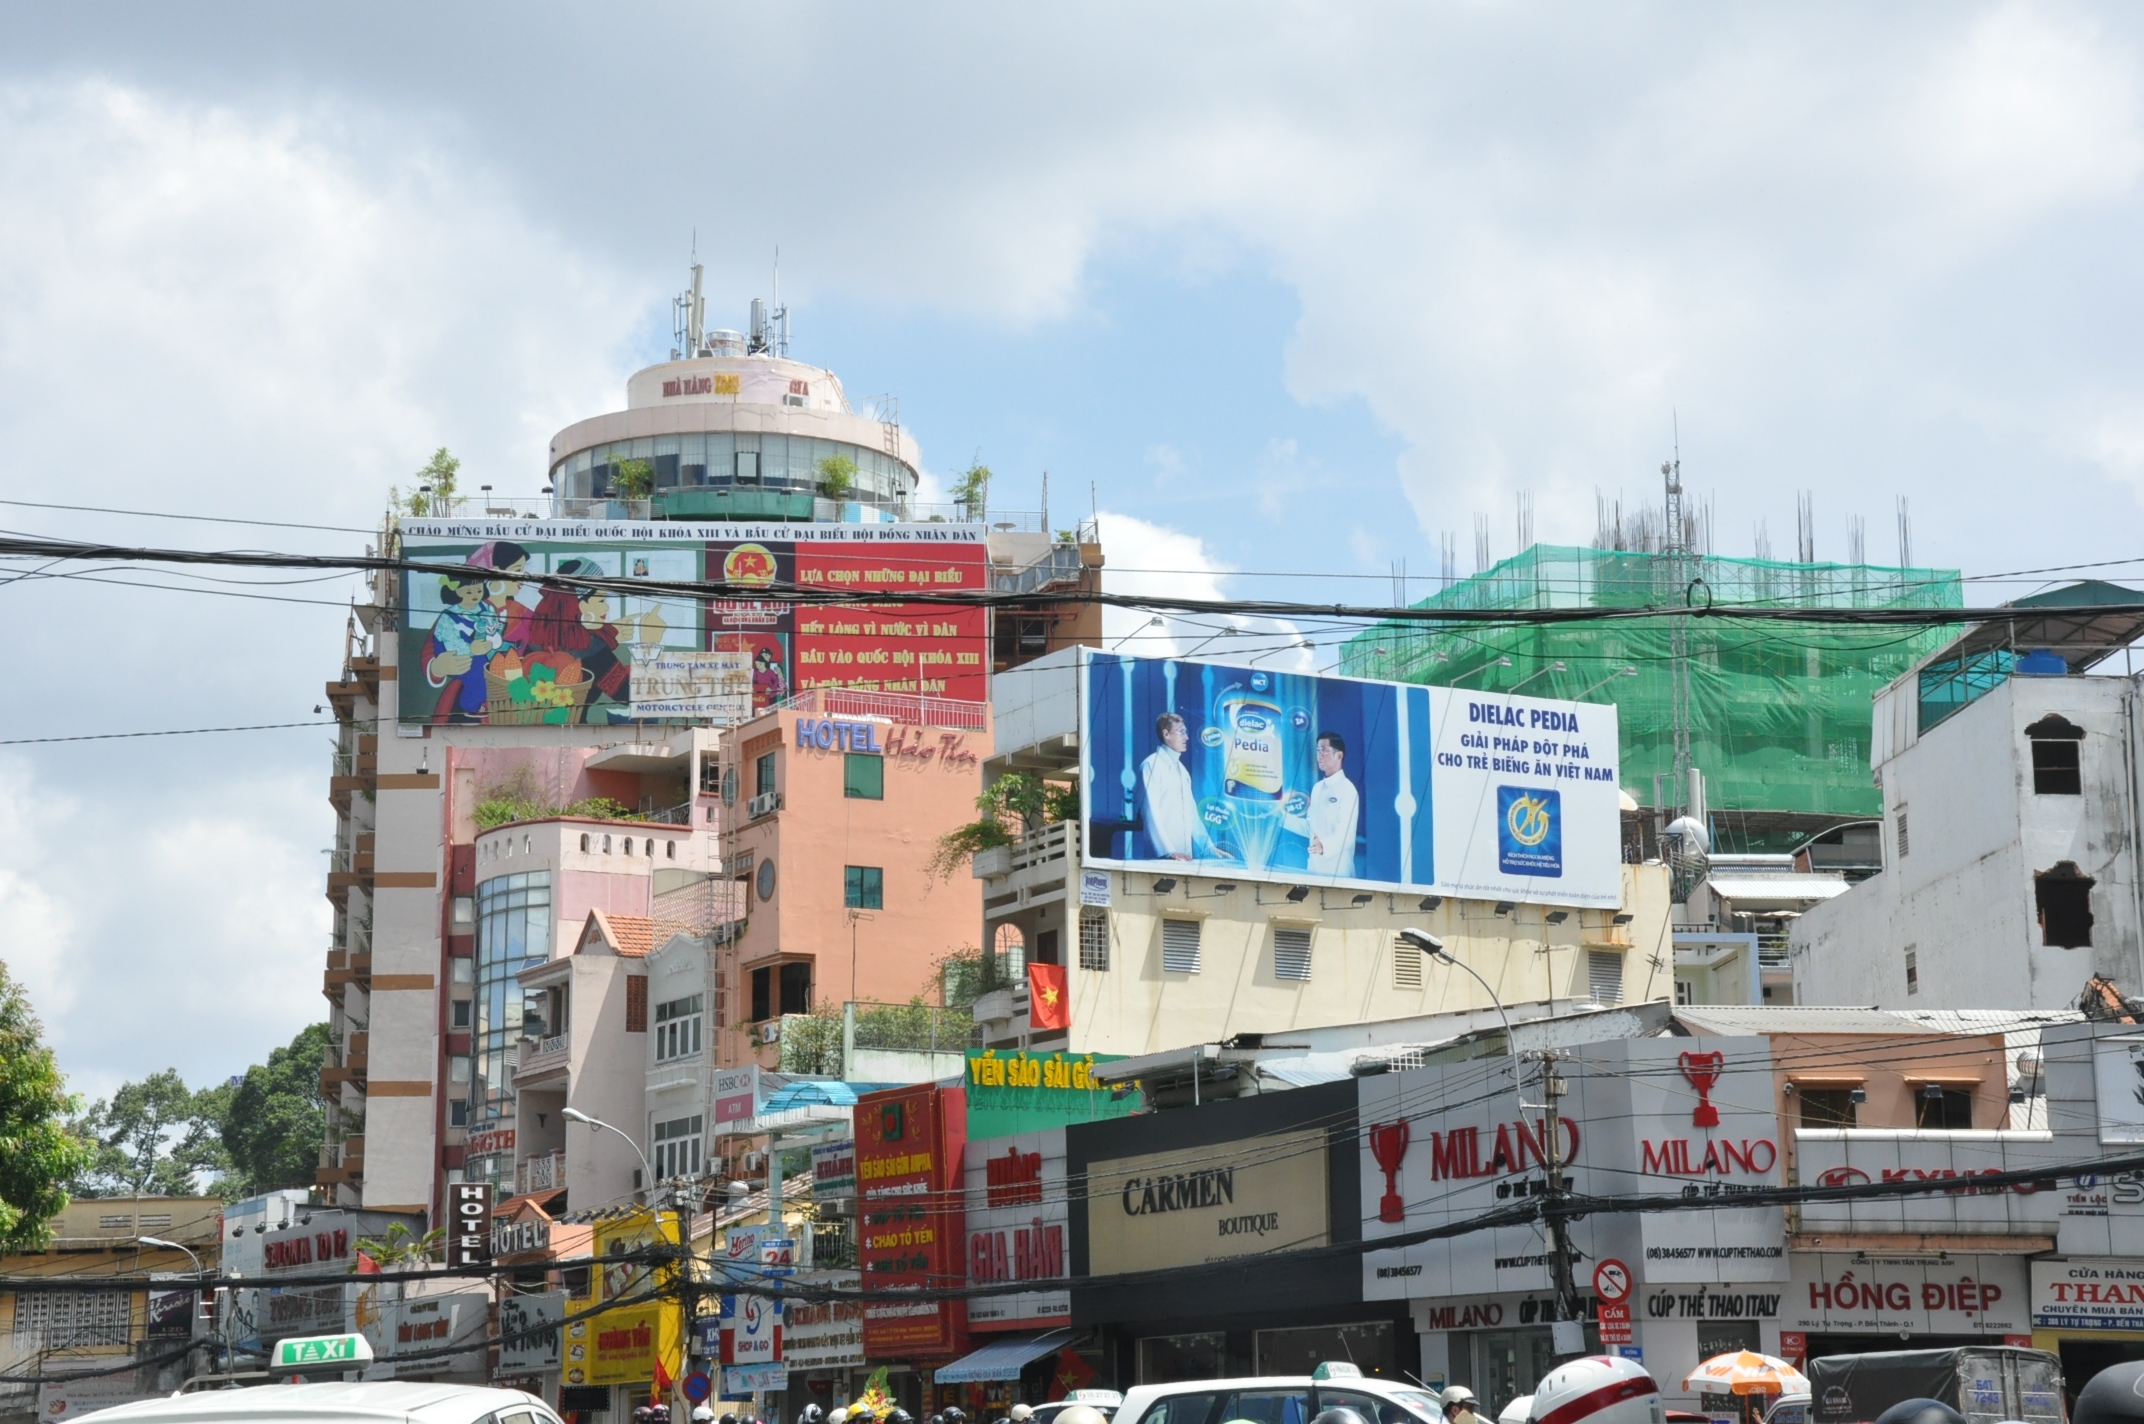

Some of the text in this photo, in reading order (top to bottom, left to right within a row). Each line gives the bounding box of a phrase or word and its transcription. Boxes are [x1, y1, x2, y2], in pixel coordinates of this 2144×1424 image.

[662, 376, 682, 398] NHÀ
[683, 374, 712, 396] HÀNG
[408, 523, 442, 536] CHÀO
[447, 522, 480, 536] MỪNG
[515, 522, 532, 536] CỬ
[535, 526, 557, 541] ĐẠI
[562, 523, 591, 537] BIỂU
[595, 524, 627, 538] QUỐC
[631, 526, 654, 541] HỘI
[659, 525, 692, 538] KHÓA
[697, 527, 720, 538] XIII
[724, 526, 740, 538] VÀ
[773, 526, 791, 539] CỬ
[794, 529, 815, 542] ĐẠI
[820, 526, 848, 540] BIỂU
[852, 528, 874, 542] HỘI
[879, 527, 910, 541] ĐỒNG
[915, 527, 948, 541] NHÂN
[952, 528, 977, 541] DÂN
[800, 566, 963, 586] LỰA CHỌN NHỮNG ĐẠI BIỂU
[800, 620, 958, 637] HẾT LÒNG VÌ NƯỚC VÌ DÂN
[655, 662, 686, 670] TRUNG
[800, 648, 980, 667] BẦU VÀO QUỐC HỘI KHÓA XIII
[884, 677, 917, 692] NHÂN
[636, 702, 706, 712] MOTORCYCLE
[1239, 717, 1265, 729] dielac
[1469, 702, 1579, 733] DIELAC PEDIA
[796, 718, 882, 753] HOTEL
[1234, 738, 1269, 753] Pedia
[1460, 731, 1590, 760] GIẢI PHÁP ĐỘT PHÁ
[1437, 752, 1613, 782] CHO TRẺ BIẾNG ĂN VIỆT NAM
[969, 1048, 1071, 1089] YẾN SÀO SÀI
[718, 1075, 739, 1092] HSBC
[727, 1102, 741, 1114] ATM
[1430, 1116, 1580, 1182] MILANO
[1641, 1139, 1777, 1175] MILANO
[1122, 1166, 1234, 1217] CARMEN
[2066, 1193, 2107, 1205] TIẾN LỘC
[460, 1186, 484, 1264] HOTEL
[1218, 1212, 1279, 1237] BOUTIQUE
[489, 1219, 545, 1255] HOTEL
[731, 1232, 755, 1253] Merino
[873, 1224, 934, 1250] CHÁO TỔ YẾN
[765, 1249, 792, 1266] 24
[970, 1217, 1063, 1285] GIA HÂN
[1697, 1246, 1783, 1259] WWW.CUPTHETHAO.COM
[1851, 1257, 1871, 1266] CÔNG
[2068, 1266, 2144, 1280] CỬA HÀNG
[1648, 1286, 1781, 1318] CÚP THỂ THAO ITALY
[1809, 1270, 2002, 1318] HỒNG ĐIỆP
[1429, 1302, 1503, 1330] MILANO
[1604, 1306, 1625, 1319] CẤM
[2042, 1304, 2143, 1315] CHUYÊN MUA BÁN
[2080, 1318, 2102, 1328] TRỌNG
[738, 1340, 769, 1352] SHOP & GO
